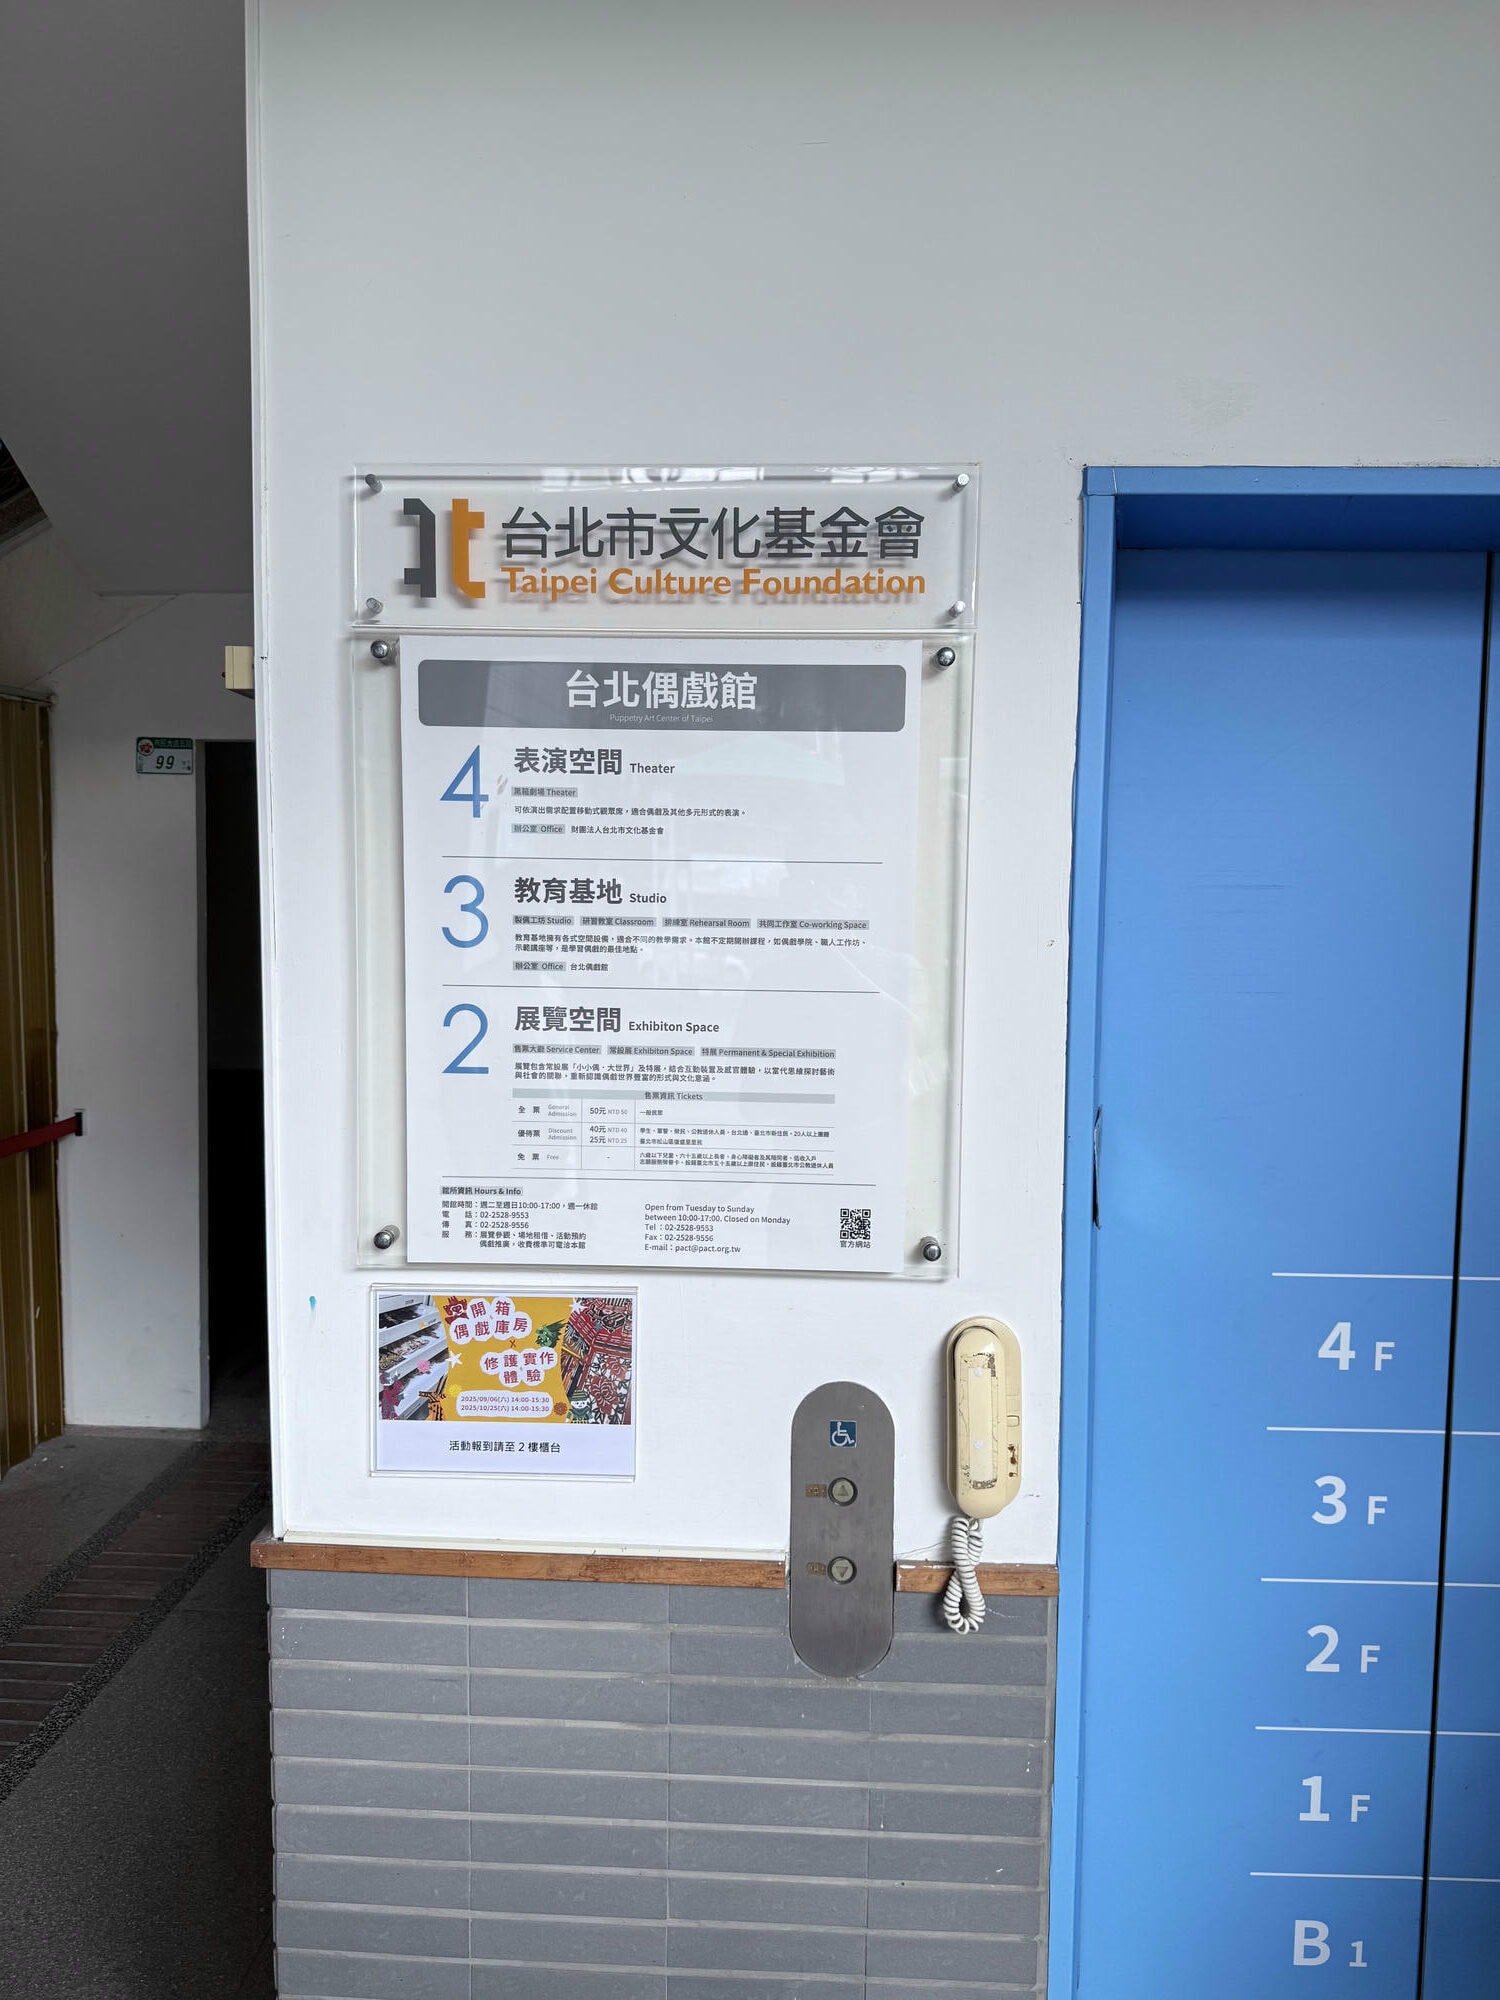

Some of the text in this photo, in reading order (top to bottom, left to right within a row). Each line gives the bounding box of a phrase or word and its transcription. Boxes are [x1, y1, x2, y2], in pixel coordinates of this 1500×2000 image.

[501, 506, 926, 560] 台北市文化基金會
[500, 567, 926, 602] Taipei Culture Foundation
[566, 669, 759, 712] 台北偶戲館
[610, 713, 714, 724] Puppetry Art Center of Taipei
[156, 755, 175, 769] 99
[513, 746, 675, 776] 表演空間 Theater
[439, 744, 490, 818] 4
[546, 788, 577, 797] Theater
[540, 825, 563, 833] Office
[571, 825, 664, 835] 財團法人台北市文化基金會
[514, 876, 667, 904] 教育基地 Studio
[441, 874, 490, 948] 3
[546, 916, 572, 925] Studio
[614, 918, 654, 926] Classroom
[689, 919, 727, 927] Rehearsal
[758, 920, 798, 928] 共同工作室
[799, 921, 843, 930] Co-working
[843, 921, 867, 930] Space
[541, 962, 564, 970] Office
[570, 963, 609, 971] 台北偶戲館
[513, 1006, 719, 1034] 展覽空間 Exhibiton Space
[441, 1003, 490, 1074] 2
[545, 1045, 573, 1054] Service
[574, 1046, 600, 1054] Center
[633, 1047, 669, 1055] Exhibiton
[670, 1047, 693, 1057] Space
[701, 1048, 717, 1057] 特展
[718, 1049, 759, 1057] Permanent
[760, 1049, 767, 1057] &
[768, 1049, 795, 1059] Special
[796, 1050, 835, 1058] Exhibition
[677, 1093, 703, 1101] Tickets
[589, 1107, 607, 1115] 50元
[589, 1125, 606, 1133] 40元
[589, 1136, 606, 1144] 25元
[474, 1187, 498, 1195] Hours
[645, 1203, 665, 1212] Open
[686, 1204, 716, 1213] Tuesday
[727, 1205, 755, 1214] Sunday
[645, 1213, 677, 1221] between
[678, 1214, 722, 1222] 10:00-17:00.
[724, 1215, 748, 1223] Closed
[761, 1216, 791, 1225] Monday
[645, 1223, 657, 1231] Tel
[441, 1231, 450, 1239] 服
[840, 1240, 871, 1249] 官方網站
[470, 1301, 511, 1318] 開箱
[453, 1317, 528, 1340] 偶戲庫房
[1317, 1322, 1396, 1372] 4 F
[484, 1352, 554, 1371] 修護實作
[503, 1369, 542, 1384] 體驗
[449, 1440, 562, 1454] 活動報到請至 2 樓櫃台
[1312, 1475, 1388, 1525] 3 F
[1305, 1624, 1381, 1674] 2 F
[1298, 1775, 1371, 1823] 1 F
[1293, 1919, 1368, 1968] B 1
